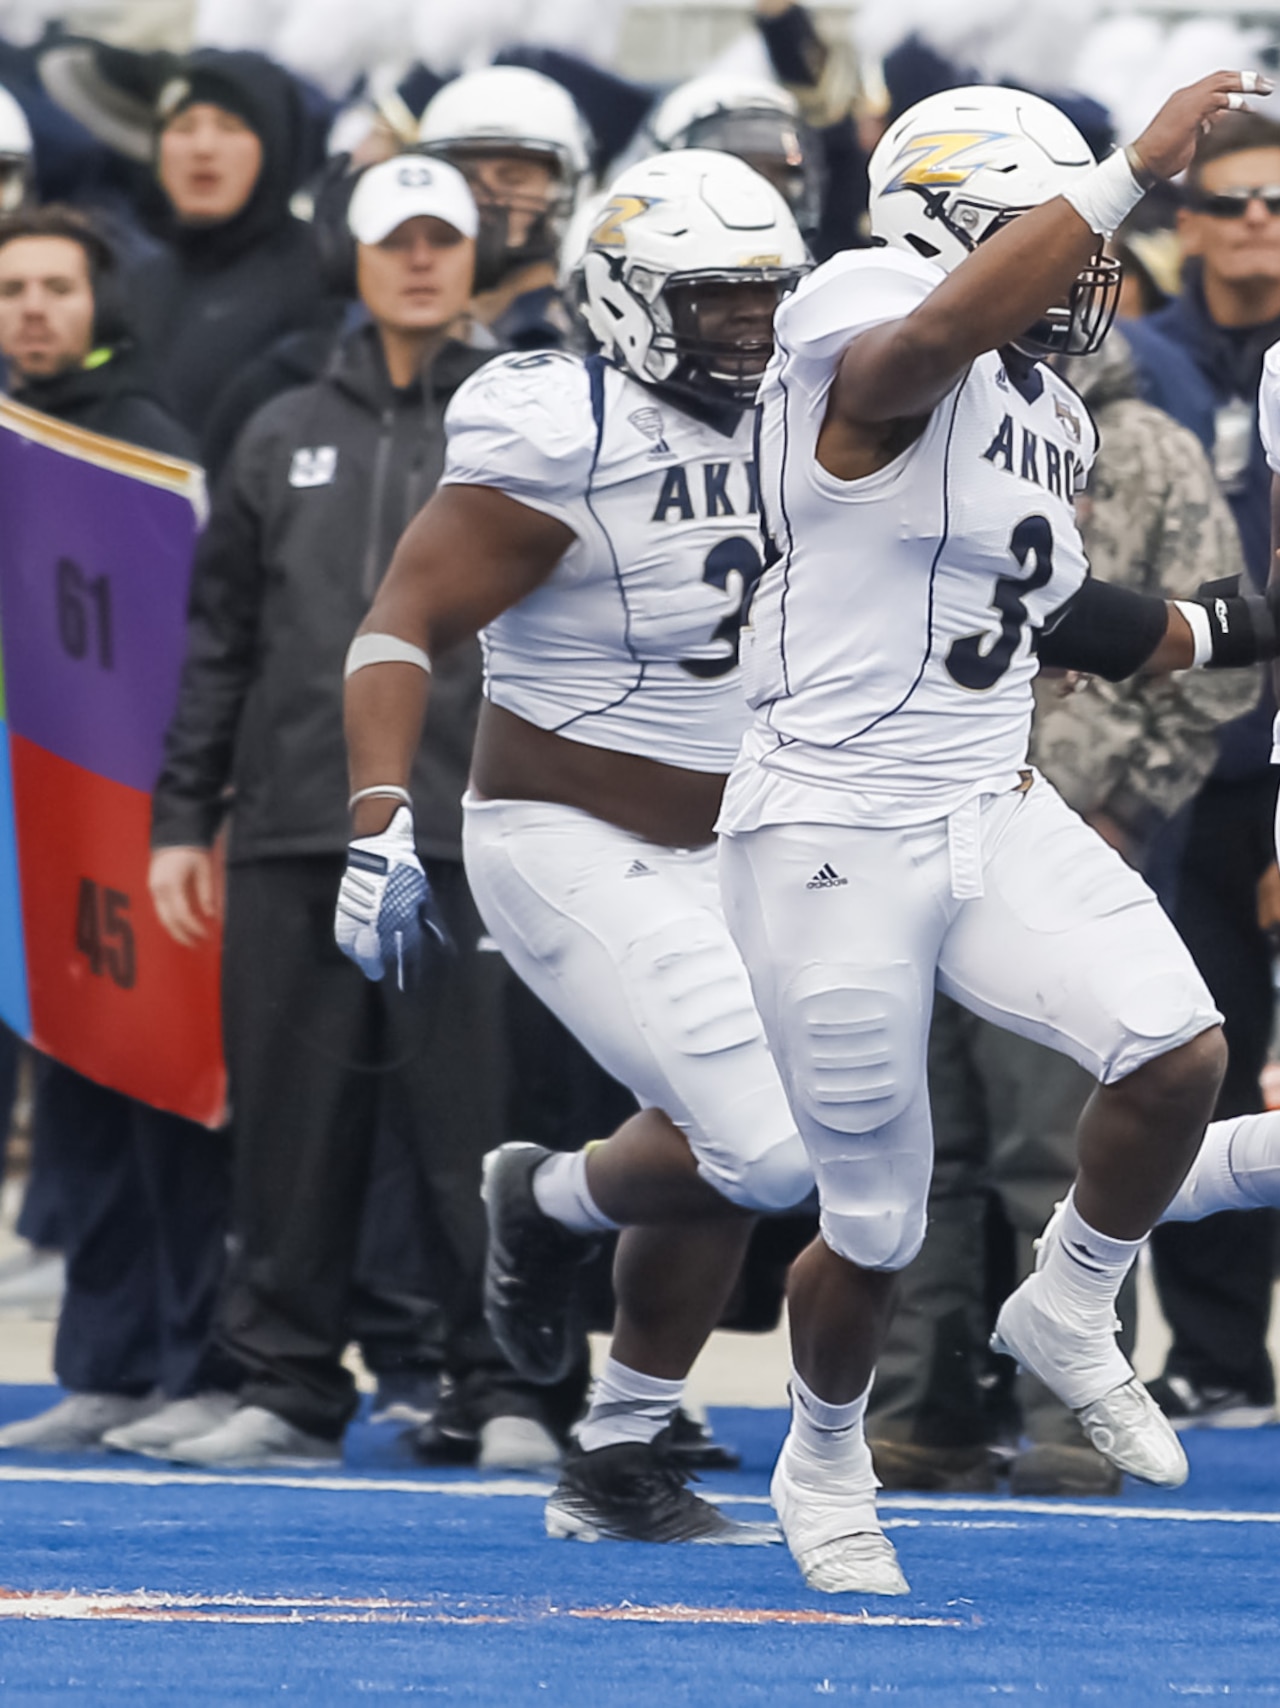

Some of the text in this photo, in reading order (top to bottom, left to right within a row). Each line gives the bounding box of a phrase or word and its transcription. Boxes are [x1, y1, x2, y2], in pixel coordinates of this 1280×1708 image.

[980, 411, 1085, 507] AKRO
[56, 556, 114, 671] 61
[75, 876, 137, 990] 45
